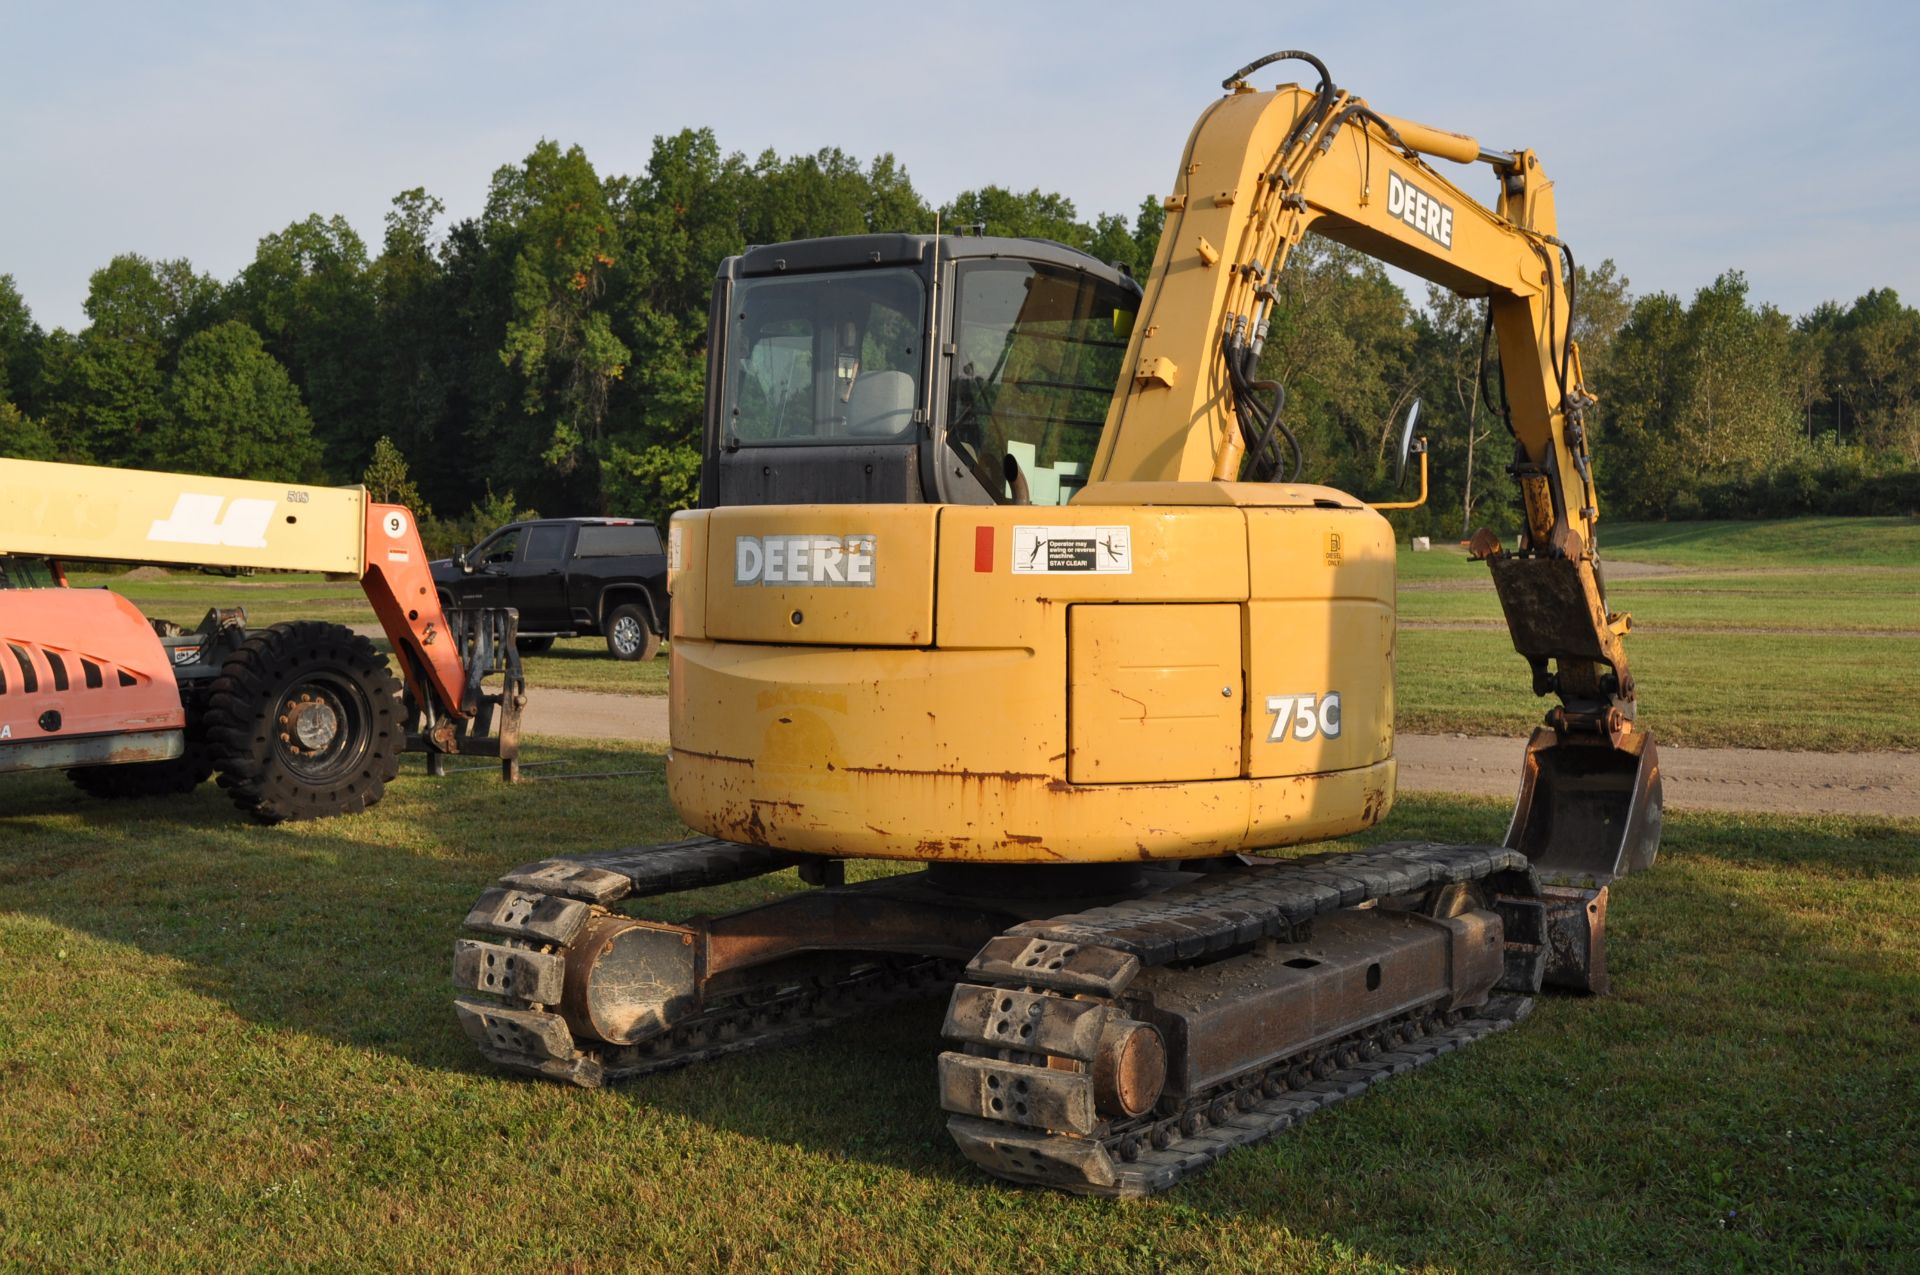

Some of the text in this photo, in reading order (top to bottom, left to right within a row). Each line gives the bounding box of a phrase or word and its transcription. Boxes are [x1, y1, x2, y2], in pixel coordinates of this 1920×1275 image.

[1388, 174, 1452, 246] DEERE
[391, 518, 400, 532] 9
[737, 540, 872, 582] DEERE
[1325, 552, 1342, 560] DIESEL
[1267, 694, 1339, 739] 75C
